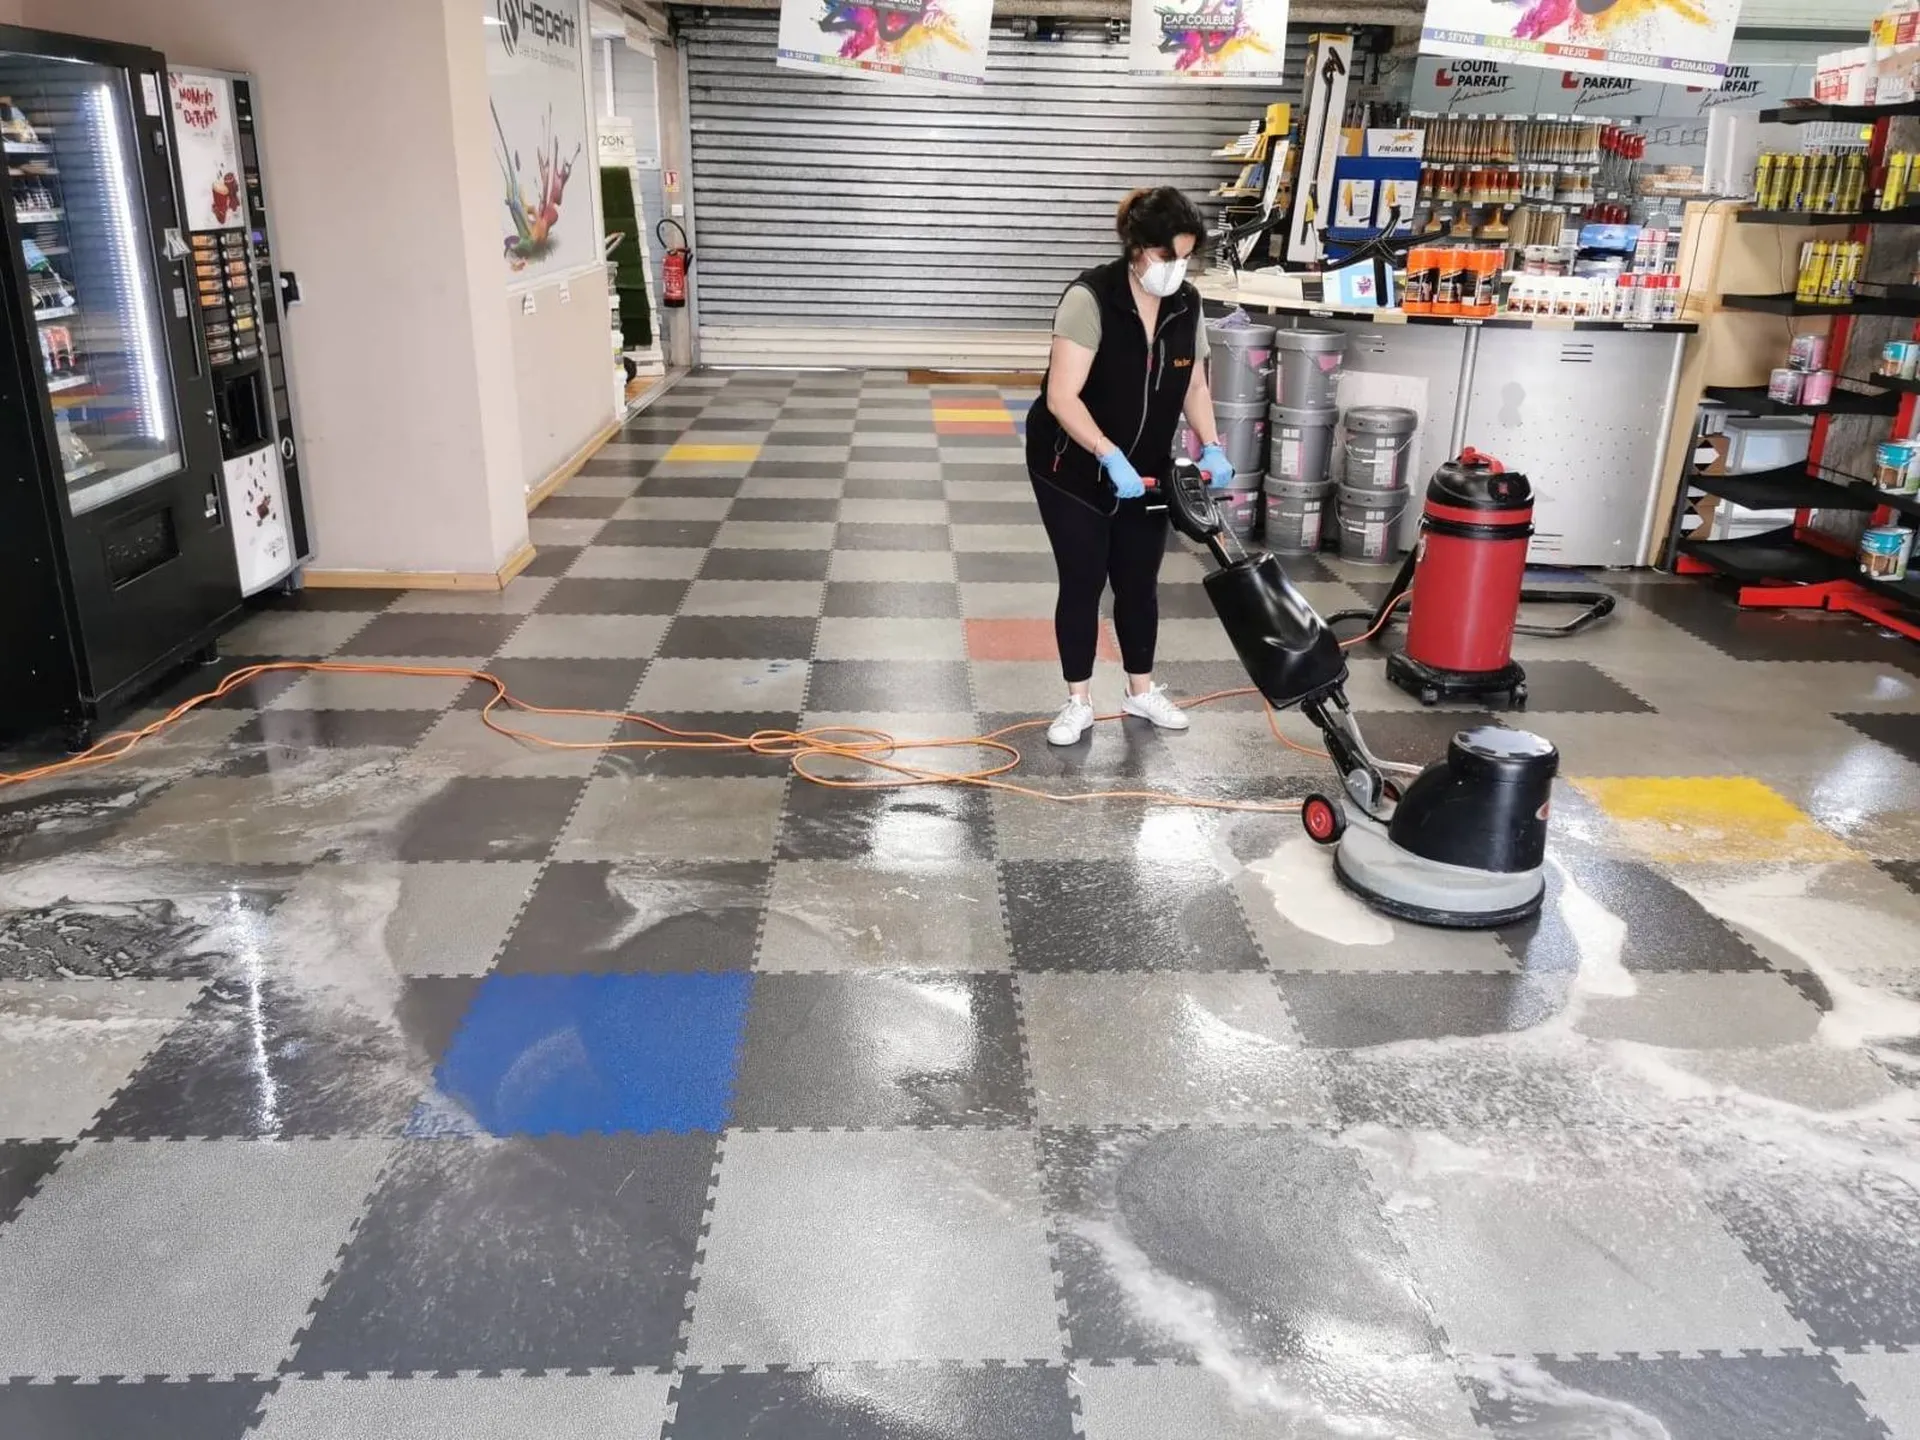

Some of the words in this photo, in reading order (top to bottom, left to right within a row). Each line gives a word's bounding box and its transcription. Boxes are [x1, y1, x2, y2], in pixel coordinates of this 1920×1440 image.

[1164, 15, 1184, 25] CAP
[1186, 15, 1235, 25] COULEURS
[1433, 31, 1445, 40] LA
[1447, 32, 1477, 43] SEYNE
[1491, 38, 1502, 47] LA
[1608, 52, 1661, 67] BRIGNOLES
[1671, 60, 1716, 73] GRIMAUD
[1451, 60, 1499, 73] L'OUTIL
[1724, 67, 1750, 78] UTIL
[1457, 75, 1510, 87] PARFAIT
[1583, 77, 1635, 89] PARFAIT
[1712, 80, 1761, 92] RFAIT
